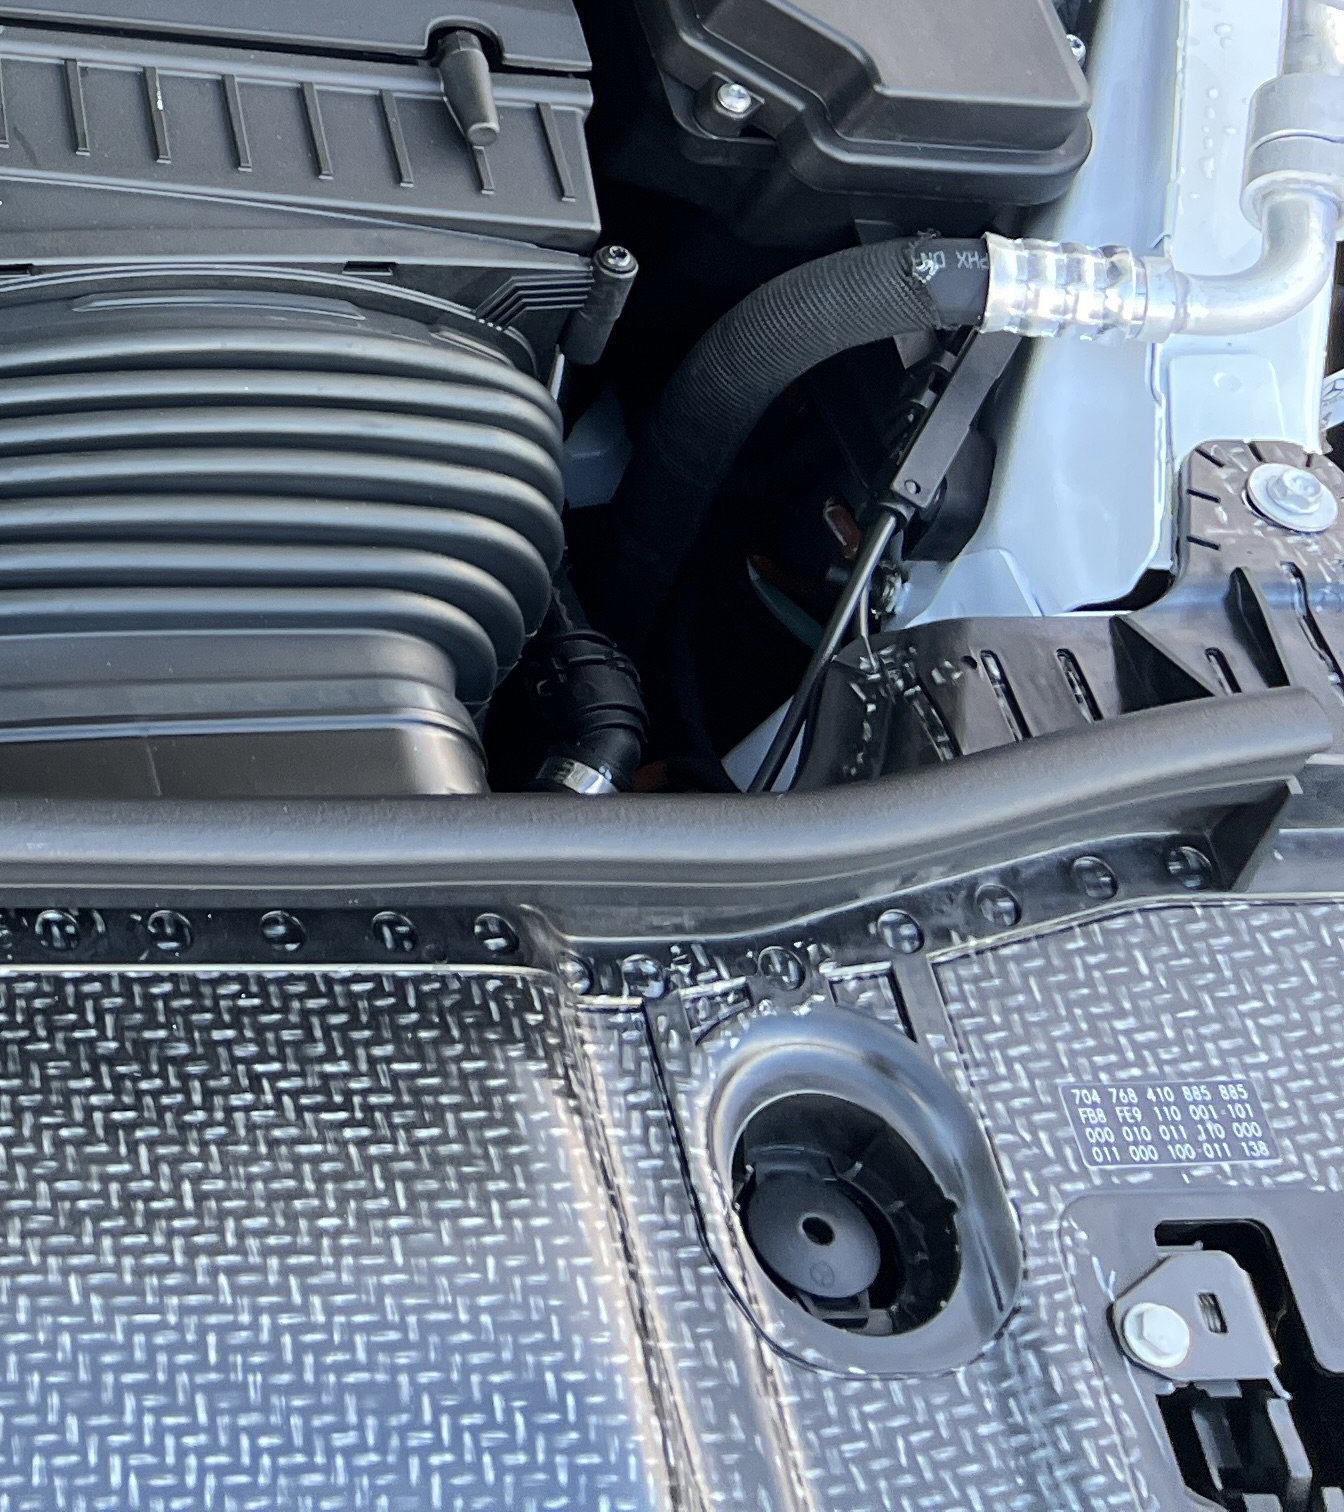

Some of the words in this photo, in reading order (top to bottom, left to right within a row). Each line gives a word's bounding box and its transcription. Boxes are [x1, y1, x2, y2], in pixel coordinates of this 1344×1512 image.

[1070, 1088, 1102, 1105] 704
[1107, 1087, 1138, 1104] 768
[1146, 1086, 1175, 1103] 410
[1181, 1085, 1212, 1102] 885
[1218, 1083, 1249, 1101] 885
[1115, 1106, 1142, 1123] FE9
[1153, 1105, 1181, 1122] 110
[1188, 1104, 1218, 1121] 001
[1227, 1102, 1253, 1119] 101
[1085, 1127, 1115, 1143] 000
[1122, 1125, 1152, 1143] 010
[1158, 1124, 1188, 1141] 011
[1232, 1121, 1262, 1138] 000
[1092, 1146, 1121, 1163] 011
[1128, 1145, 1159, 1162] 000
[1167, 1143, 1196, 1160] 100
[1202, 1142, 1232, 1159] 011
[1240, 1140, 1270, 1157] 138
